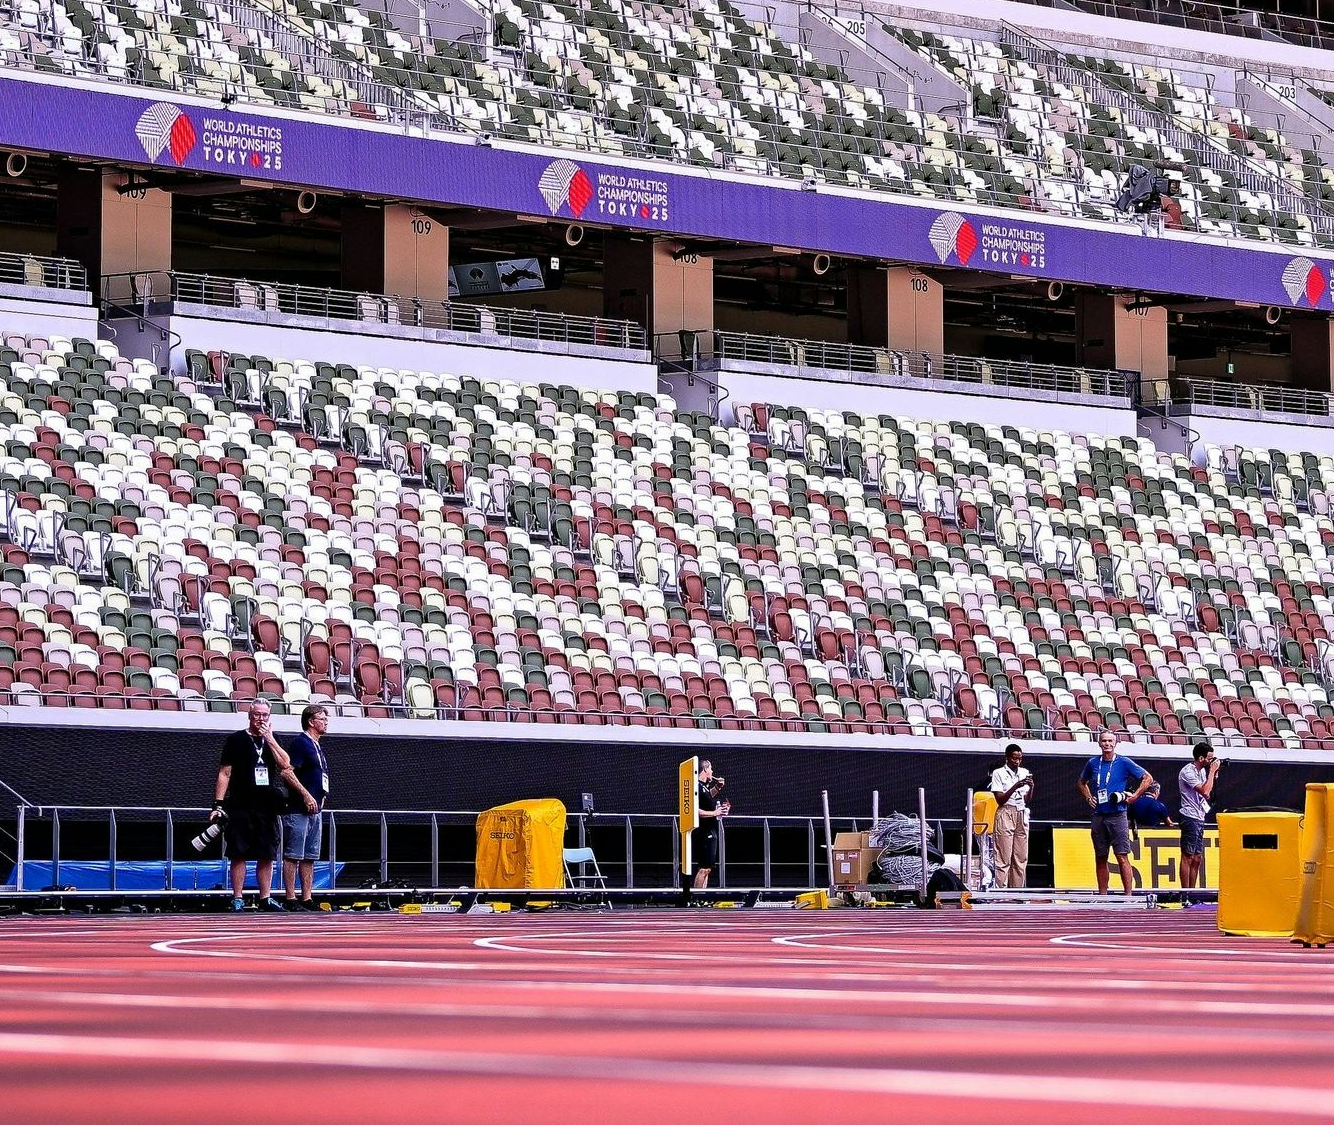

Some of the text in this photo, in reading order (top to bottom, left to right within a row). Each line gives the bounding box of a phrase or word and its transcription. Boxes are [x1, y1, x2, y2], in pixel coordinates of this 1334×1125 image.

[847, 20, 865, 35] 205
[1279, 86, 1296, 99] 203
[203, 118, 281, 140] WORLD ATHLETICS
[203, 132, 282, 154] CHAMPIONSHIPS
[203, 146, 282, 169] TOKYO25
[598, 172, 667, 193] WORLD ATHLETICS
[126, 188, 147, 200] 109
[598, 187, 667, 206] CHAMPIONSHIPS
[598, 200, 668, 221] TOKYO25
[410, 219, 431, 235] 109
[982, 224, 1044, 242] WORLD ATHLETICS
[982, 236, 1044, 255] CHAMPIONSHIPS
[910, 277, 928, 292] 108
[682, 779, 690, 815] SEIKO
[490, 831, 515, 840] SEIKO
